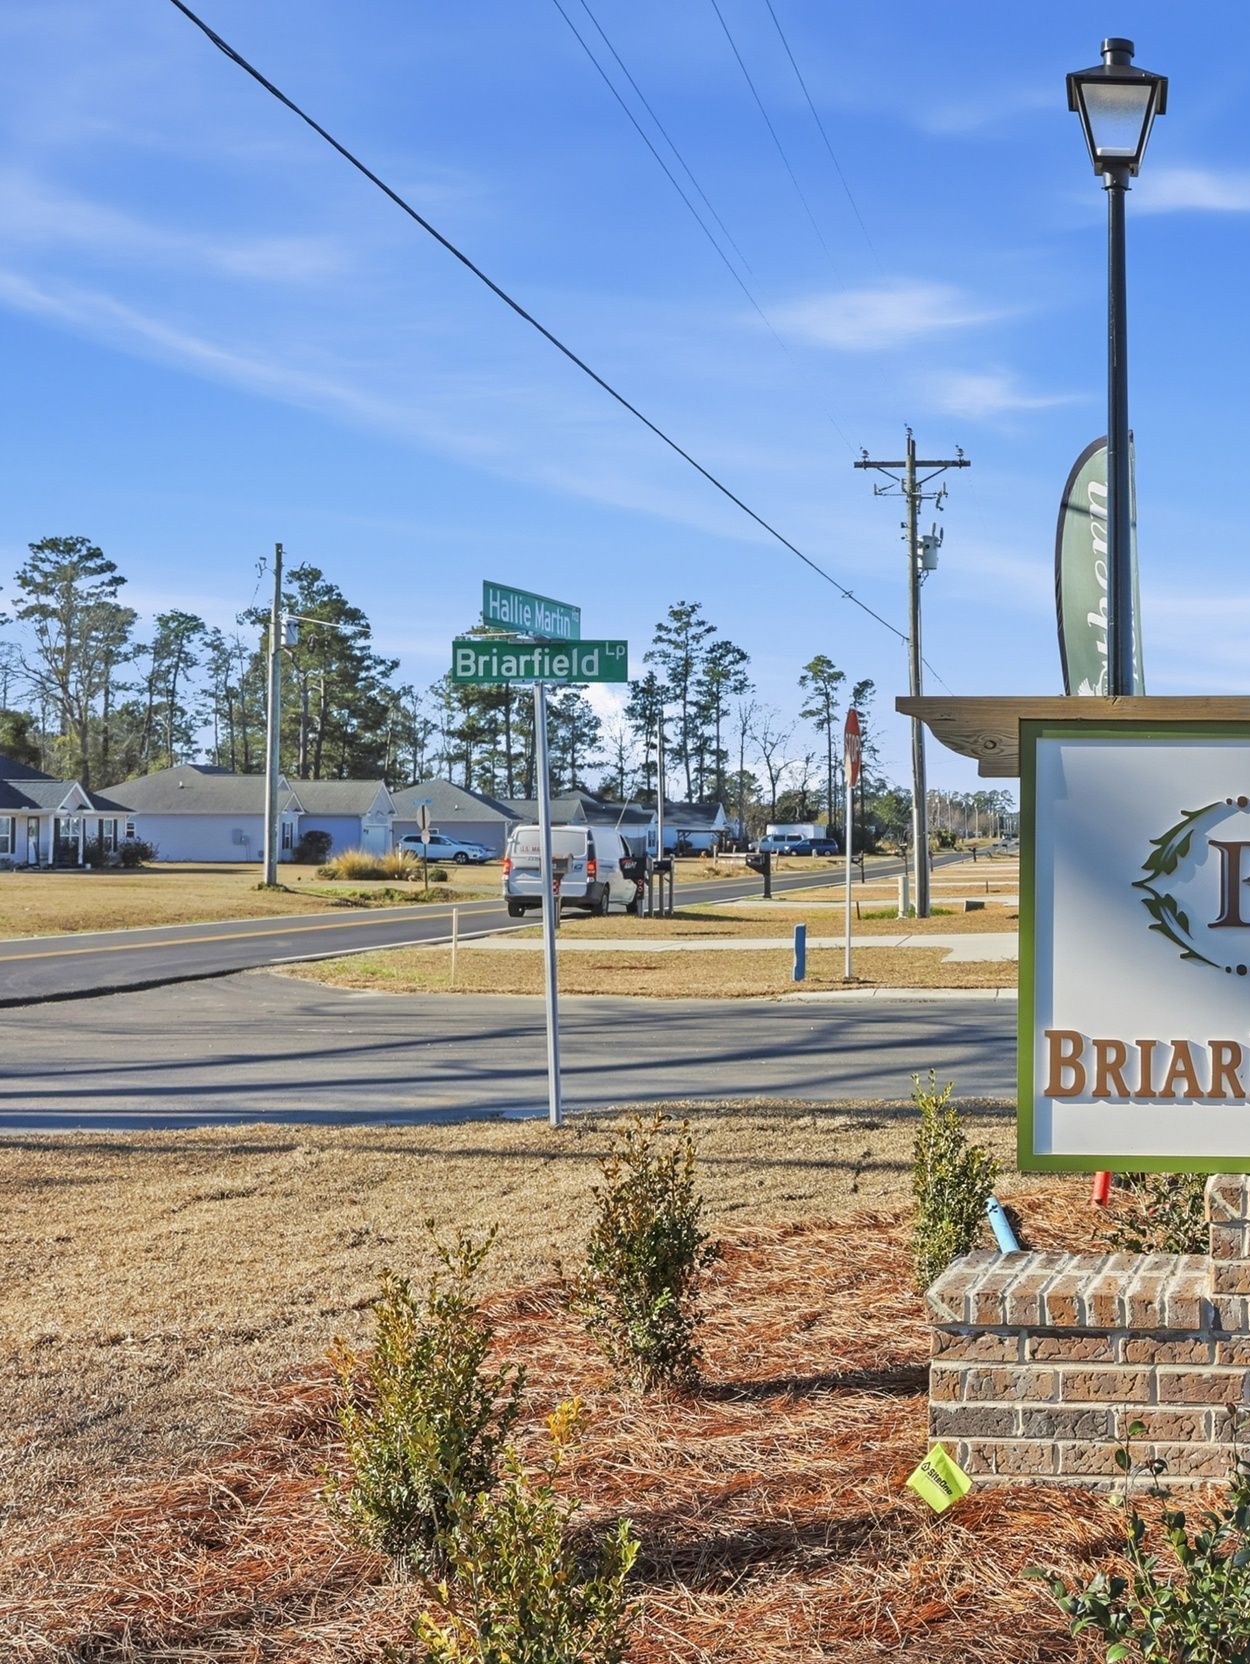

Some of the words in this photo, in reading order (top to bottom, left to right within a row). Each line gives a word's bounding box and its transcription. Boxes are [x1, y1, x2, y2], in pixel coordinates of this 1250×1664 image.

[489, 588, 532, 627] Hallie
[534, 601, 571, 637] Martin
[456, 648, 599, 677] Briarfield
[605, 641, 626, 660] Lp
